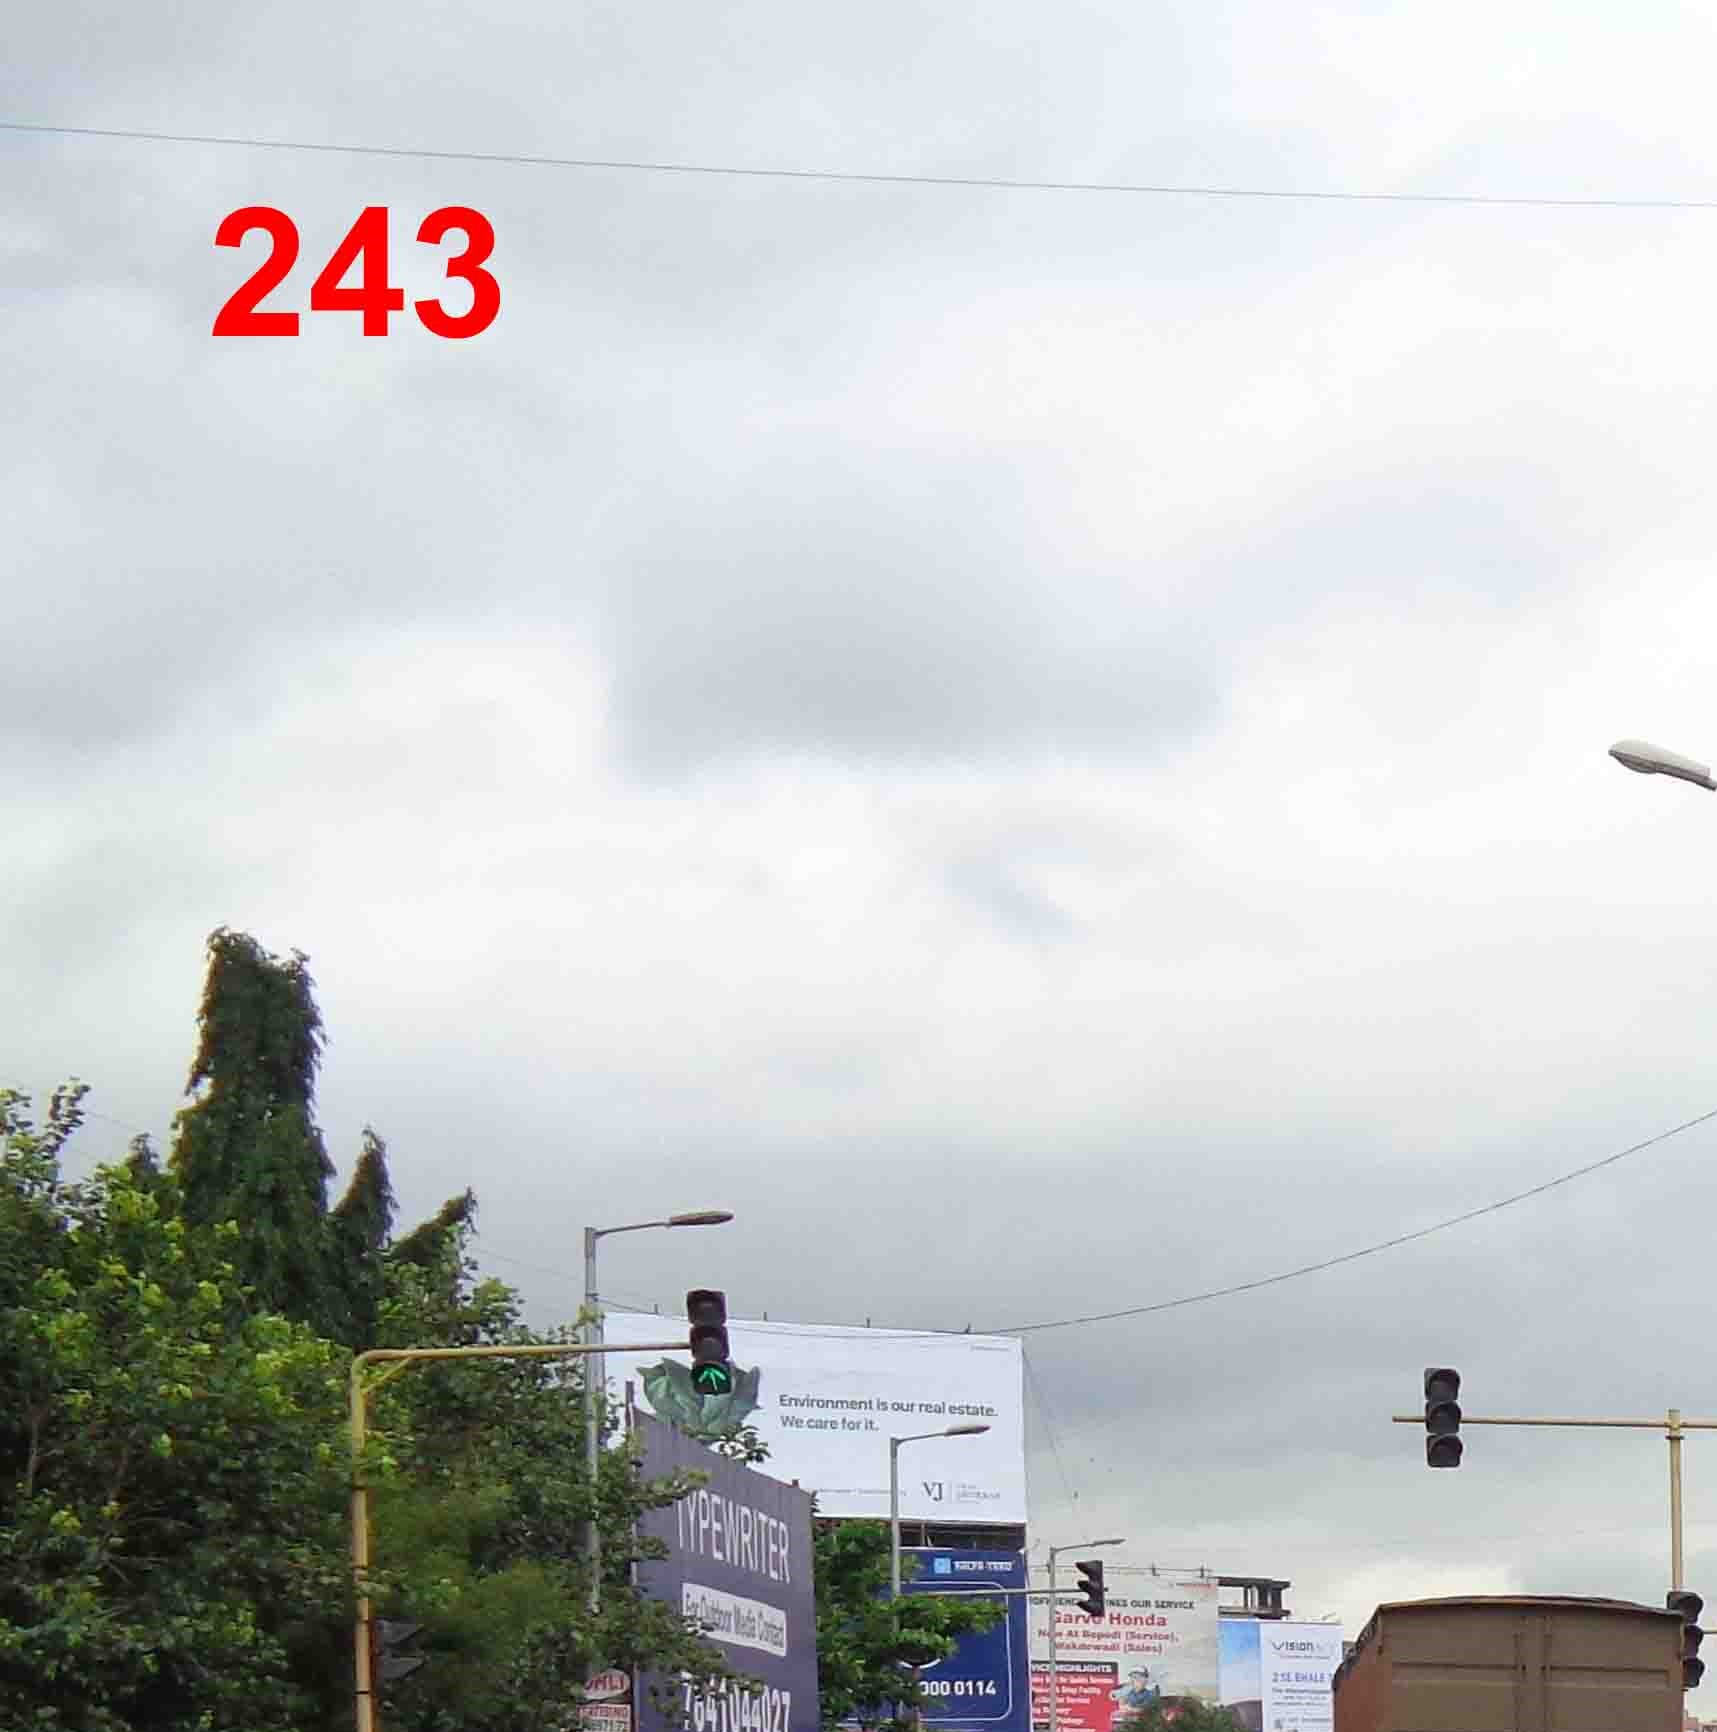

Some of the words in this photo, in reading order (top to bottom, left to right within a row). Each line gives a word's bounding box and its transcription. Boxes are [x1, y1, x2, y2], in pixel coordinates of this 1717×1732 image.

[779, 1394, 873, 1412] Environment
[876, 1398, 888, 1411] is
[891, 1401, 914, 1413] our
[919, 1402, 945, 1415] real
[948, 1404, 998, 1417] estate.
[780, 1415, 804, 1428] We
[806, 1418, 838, 1430] care
[842, 1417, 862, 1430] for
[864, 1417, 880, 1431] it.
[923, 1482, 944, 1501] VJ
[677, 1488, 790, 1585] TYPEWRITER
[1110, 1612, 1168, 1627] Honda
[1038, 1629, 1063, 1639] Nw
[954, 1680, 997, 1696] 0114
